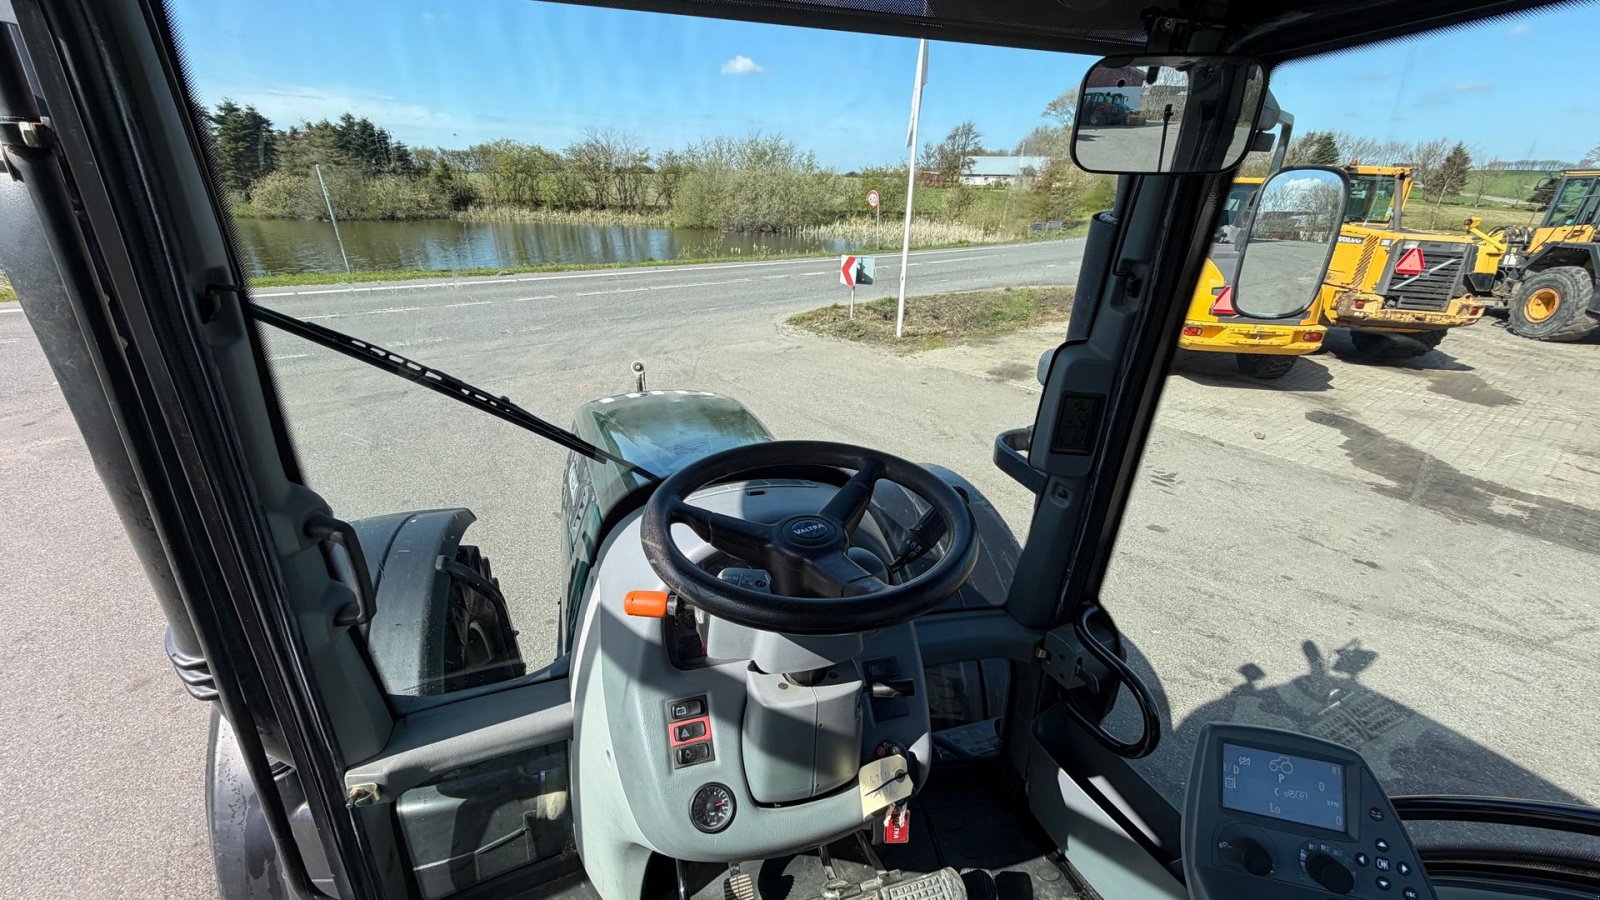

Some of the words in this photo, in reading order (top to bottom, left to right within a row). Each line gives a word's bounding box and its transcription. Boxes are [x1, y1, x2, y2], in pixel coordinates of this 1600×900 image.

[793, 523, 825, 535] VALTRA
[1278, 774, 1285, 783] P
[1376, 858, 1390, 871] OK
